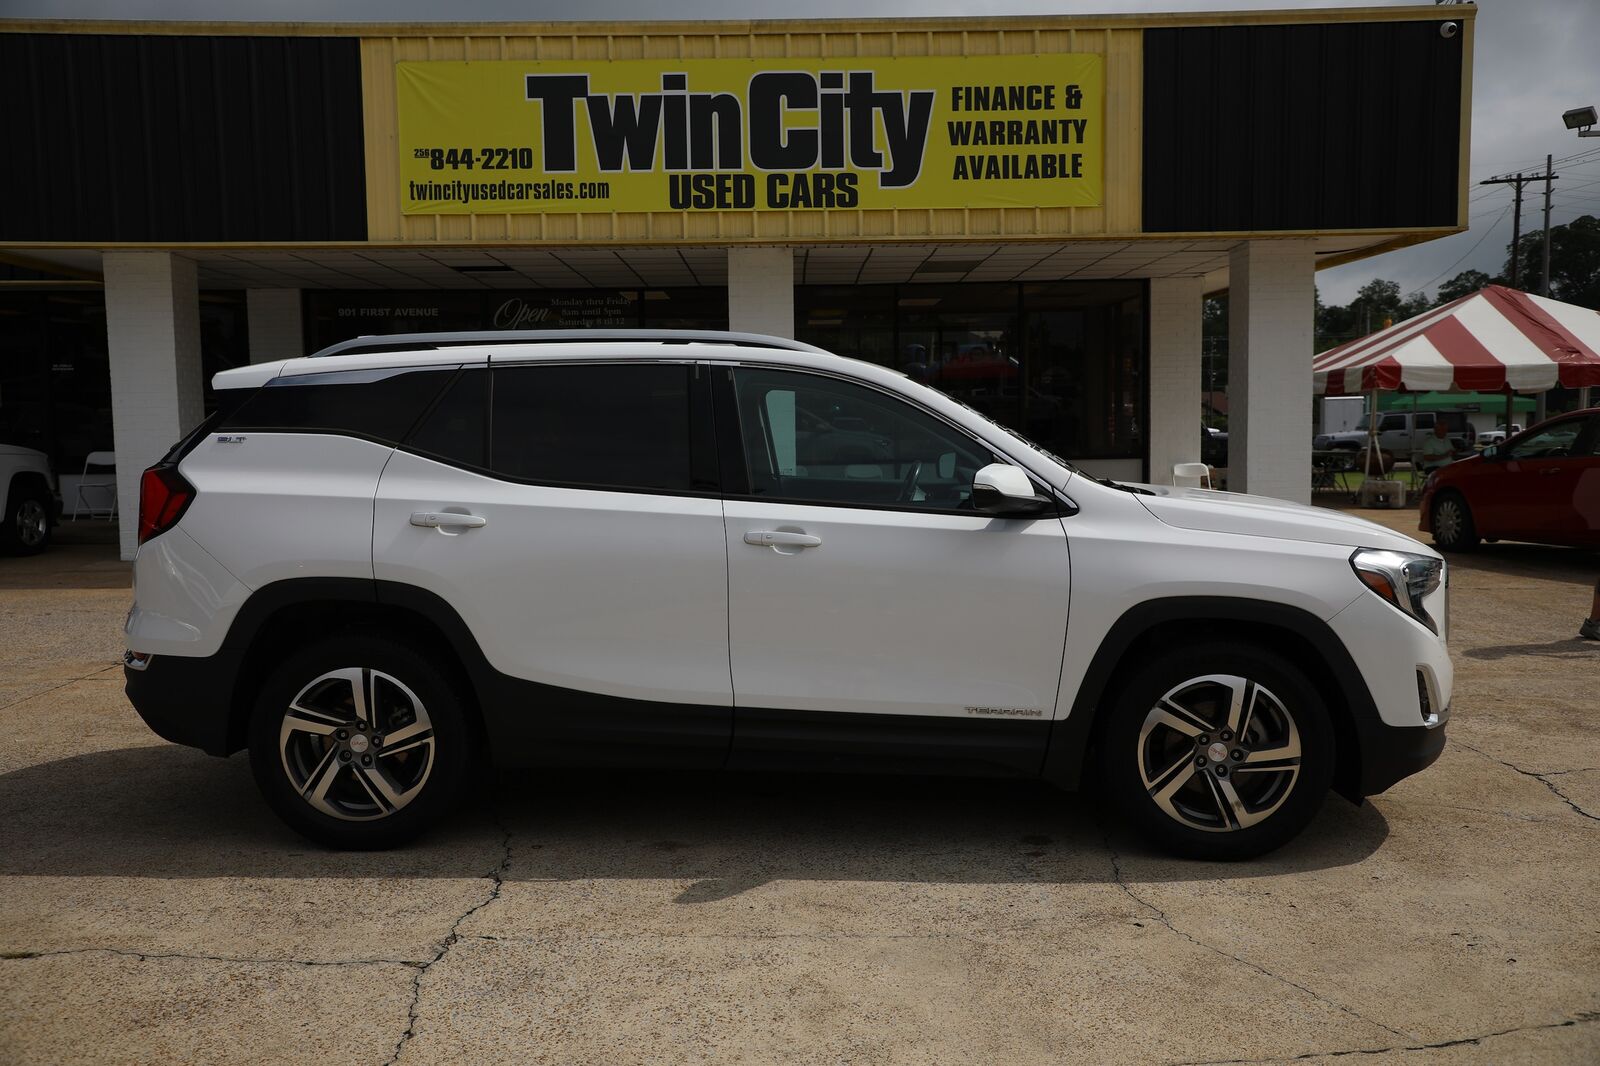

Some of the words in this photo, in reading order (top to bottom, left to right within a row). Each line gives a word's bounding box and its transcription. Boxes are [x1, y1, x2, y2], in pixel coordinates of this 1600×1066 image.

[951, 85, 1056, 112] FINANCE
[1065, 84, 1083, 110] &
[947, 119, 1088, 146] WARRANTY
[952, 153, 1083, 181] AVAILABLE
[409, 180, 610, 203] twincityusedcarsales.com
[669, 174, 756, 209] USED
[766, 173, 859, 209] CARS
[338, 308, 356, 317] 901
[360, 308, 392, 317] FIRST
[394, 308, 439, 317] AVENUE
[494, 298, 551, 330] Open
